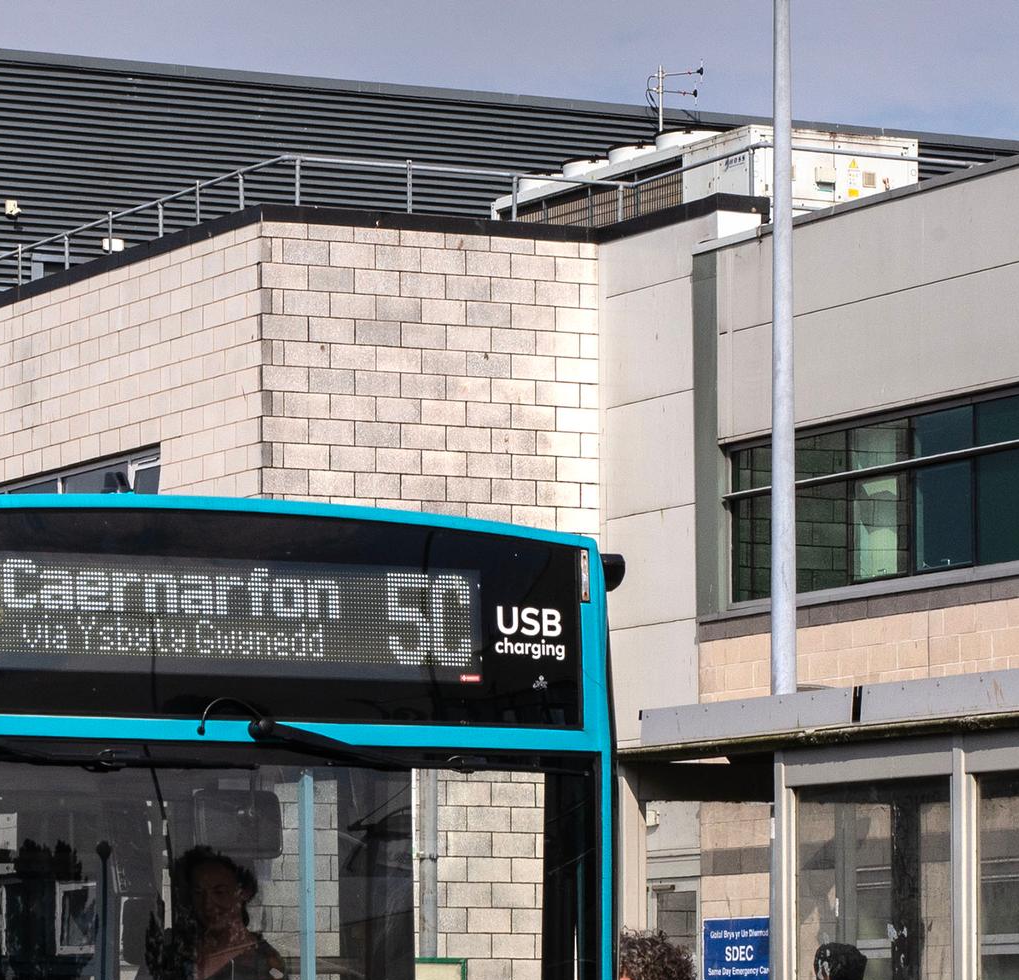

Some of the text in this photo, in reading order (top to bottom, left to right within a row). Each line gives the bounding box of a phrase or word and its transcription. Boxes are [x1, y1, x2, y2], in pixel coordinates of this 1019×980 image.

[2, 558, 339, 619] Caernarfon
[386, 572, 472, 667] 50
[496, 606, 561, 637] USB
[22, 613, 324, 658] via Ysbyty Gwynedd
[494, 638, 566, 661] charging
[725, 945, 754, 962] SDEC
[708, 968, 721, 976] Same
[722, 968, 731, 977] Day
